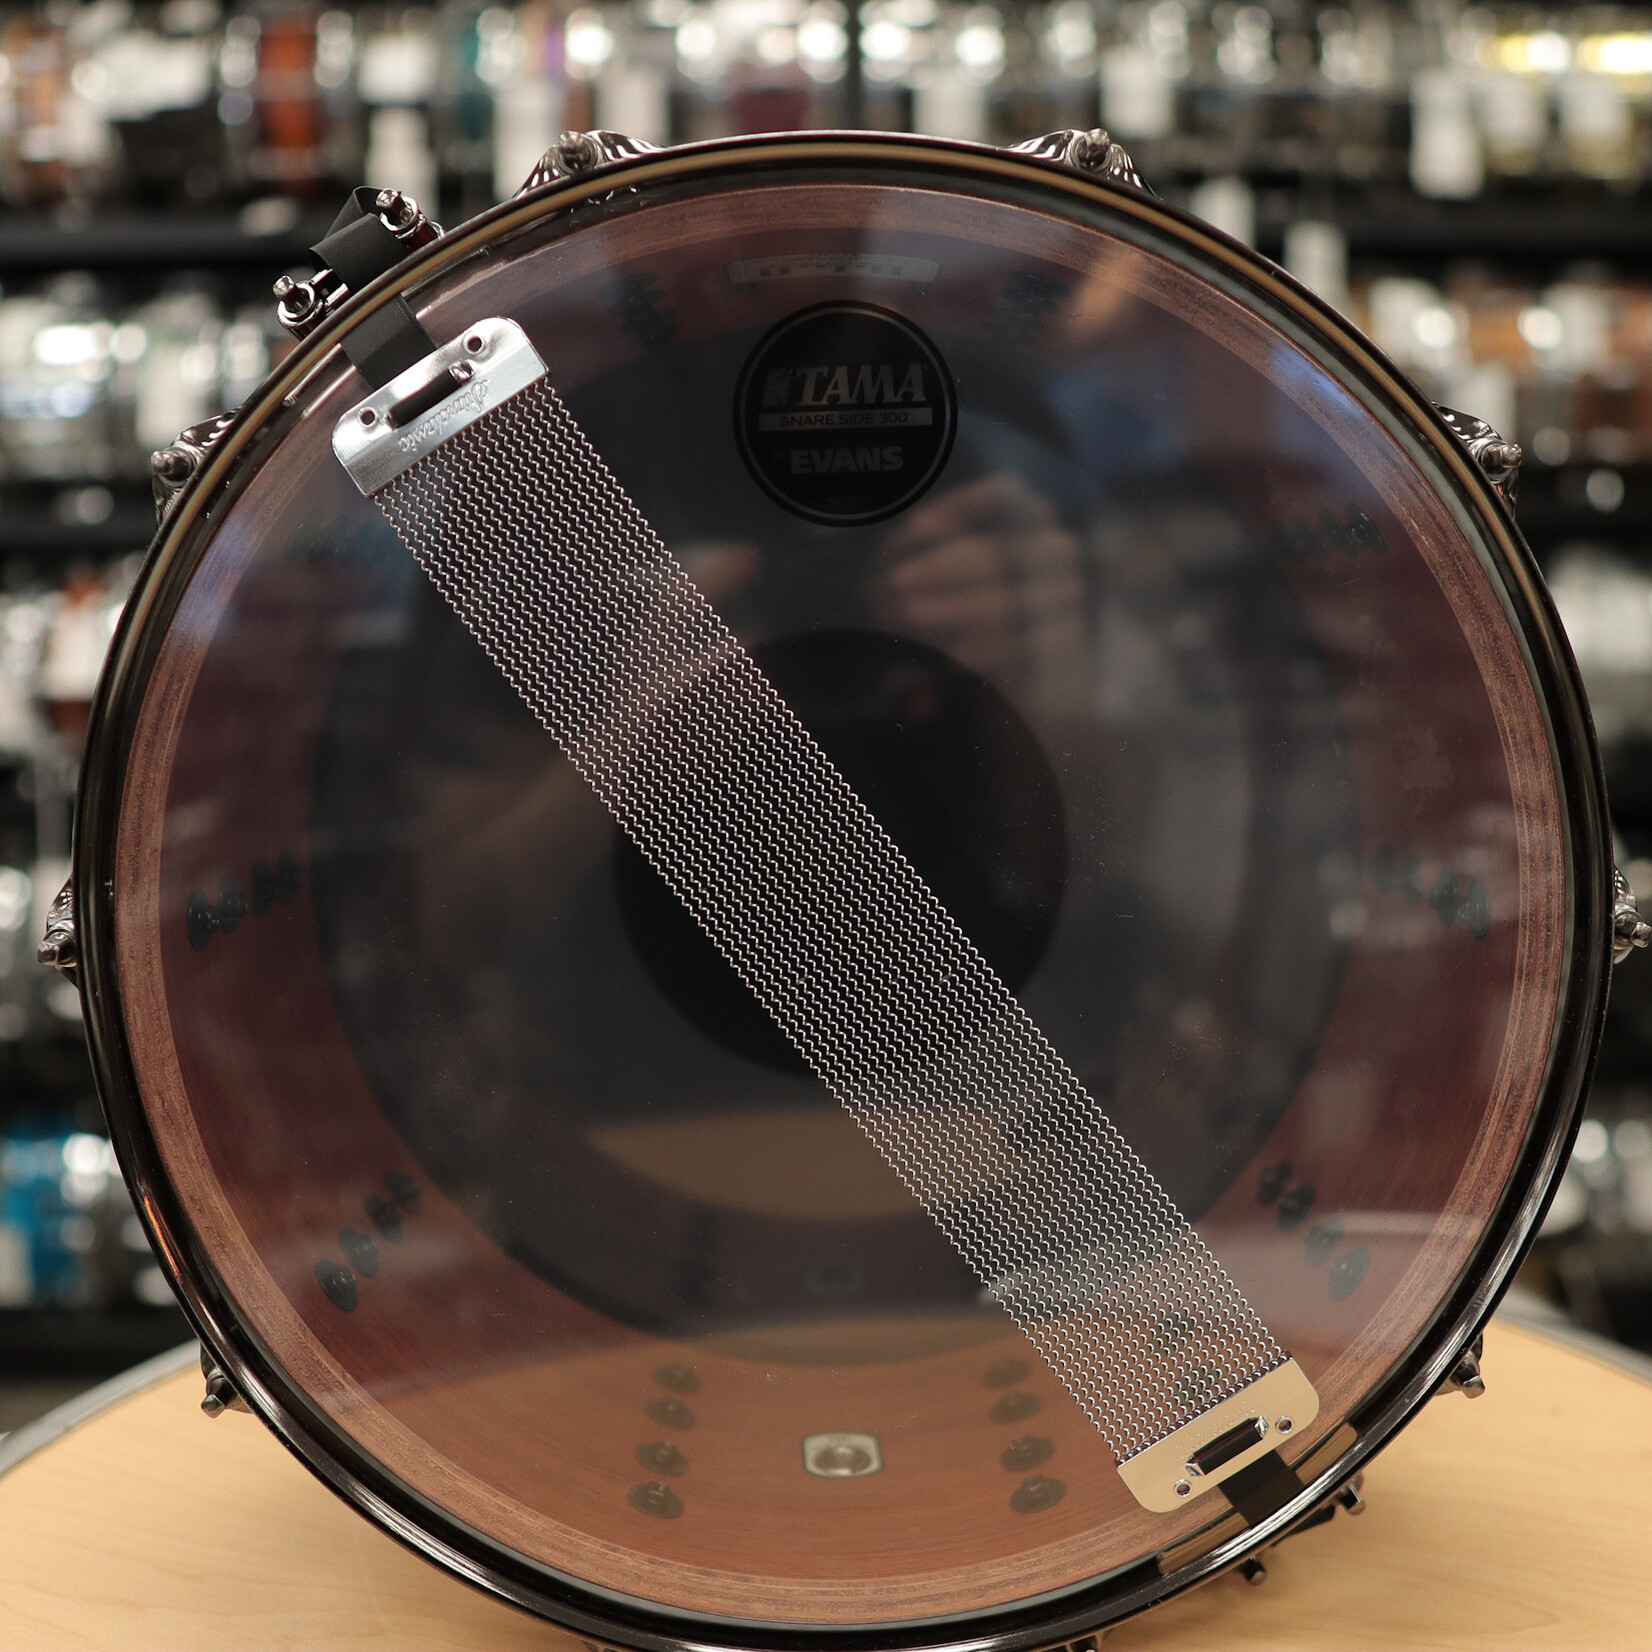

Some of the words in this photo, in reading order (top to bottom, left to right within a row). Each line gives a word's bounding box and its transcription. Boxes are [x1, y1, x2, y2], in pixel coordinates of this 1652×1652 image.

[795, 363, 927, 407] TAMA
[397, 379, 490, 452] Starclassic
[779, 414, 835, 428] SNARE
[838, 412, 875, 426] SIDE
[878, 411, 908, 424] 300
[790, 446, 904, 475] EVANS
